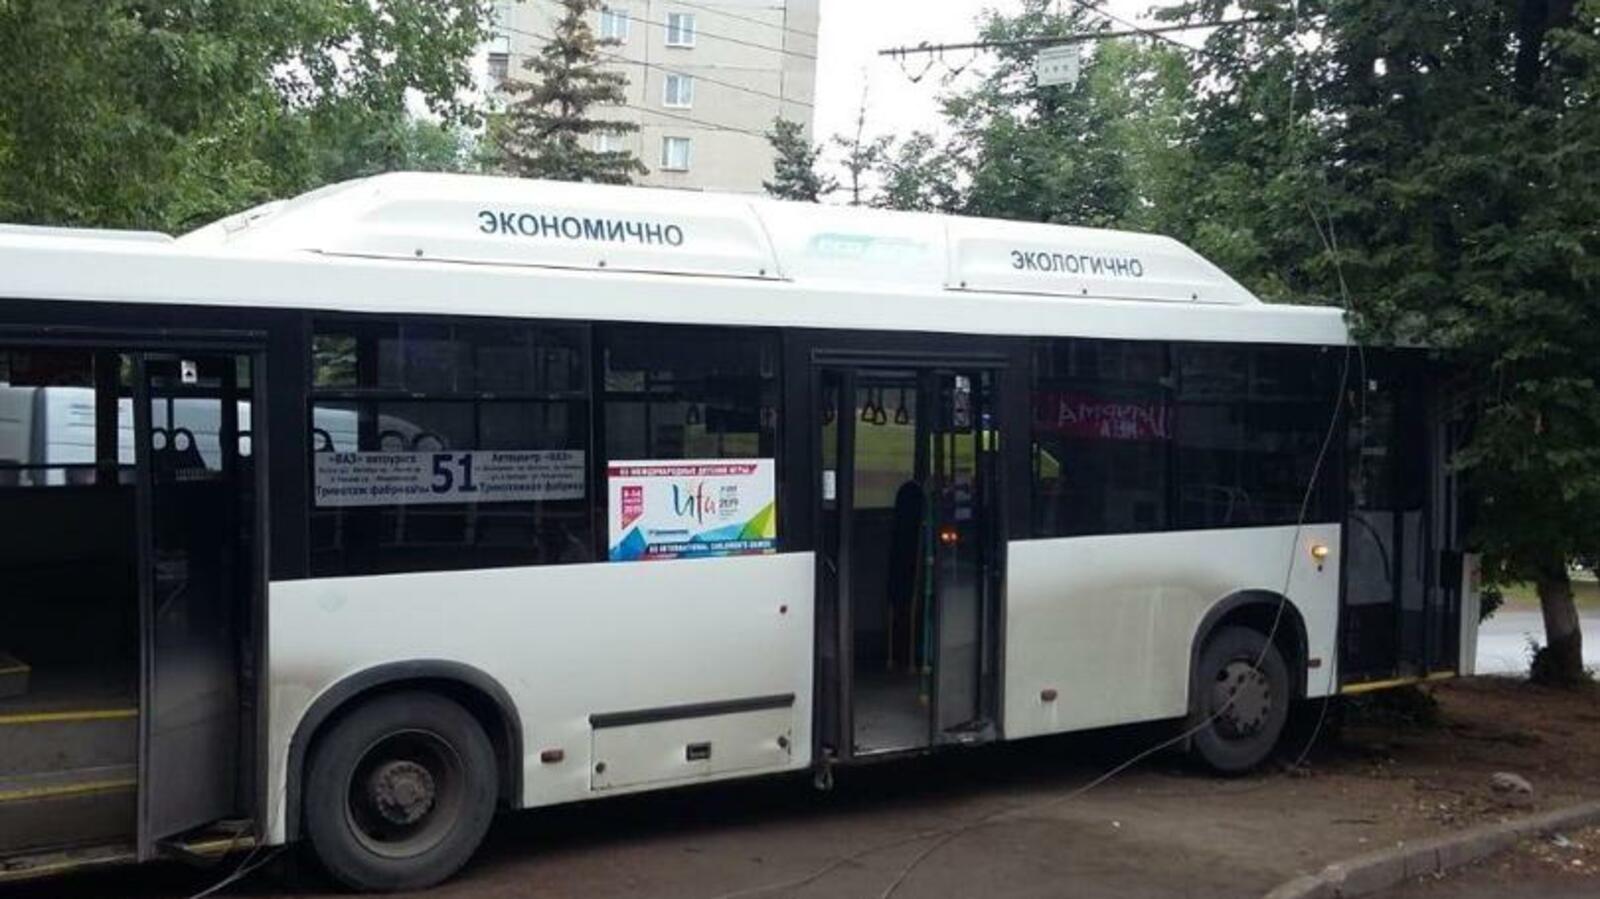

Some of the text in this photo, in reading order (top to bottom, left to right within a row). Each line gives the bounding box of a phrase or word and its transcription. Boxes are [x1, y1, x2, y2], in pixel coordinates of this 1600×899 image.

[478, 210, 684, 247] ЭКОНОМИЧНО
[1010, 249, 1144, 278] ЭКОЛОГИЧНО
[431, 453, 477, 494] 51
[672, 481, 716, 525] Ufa
